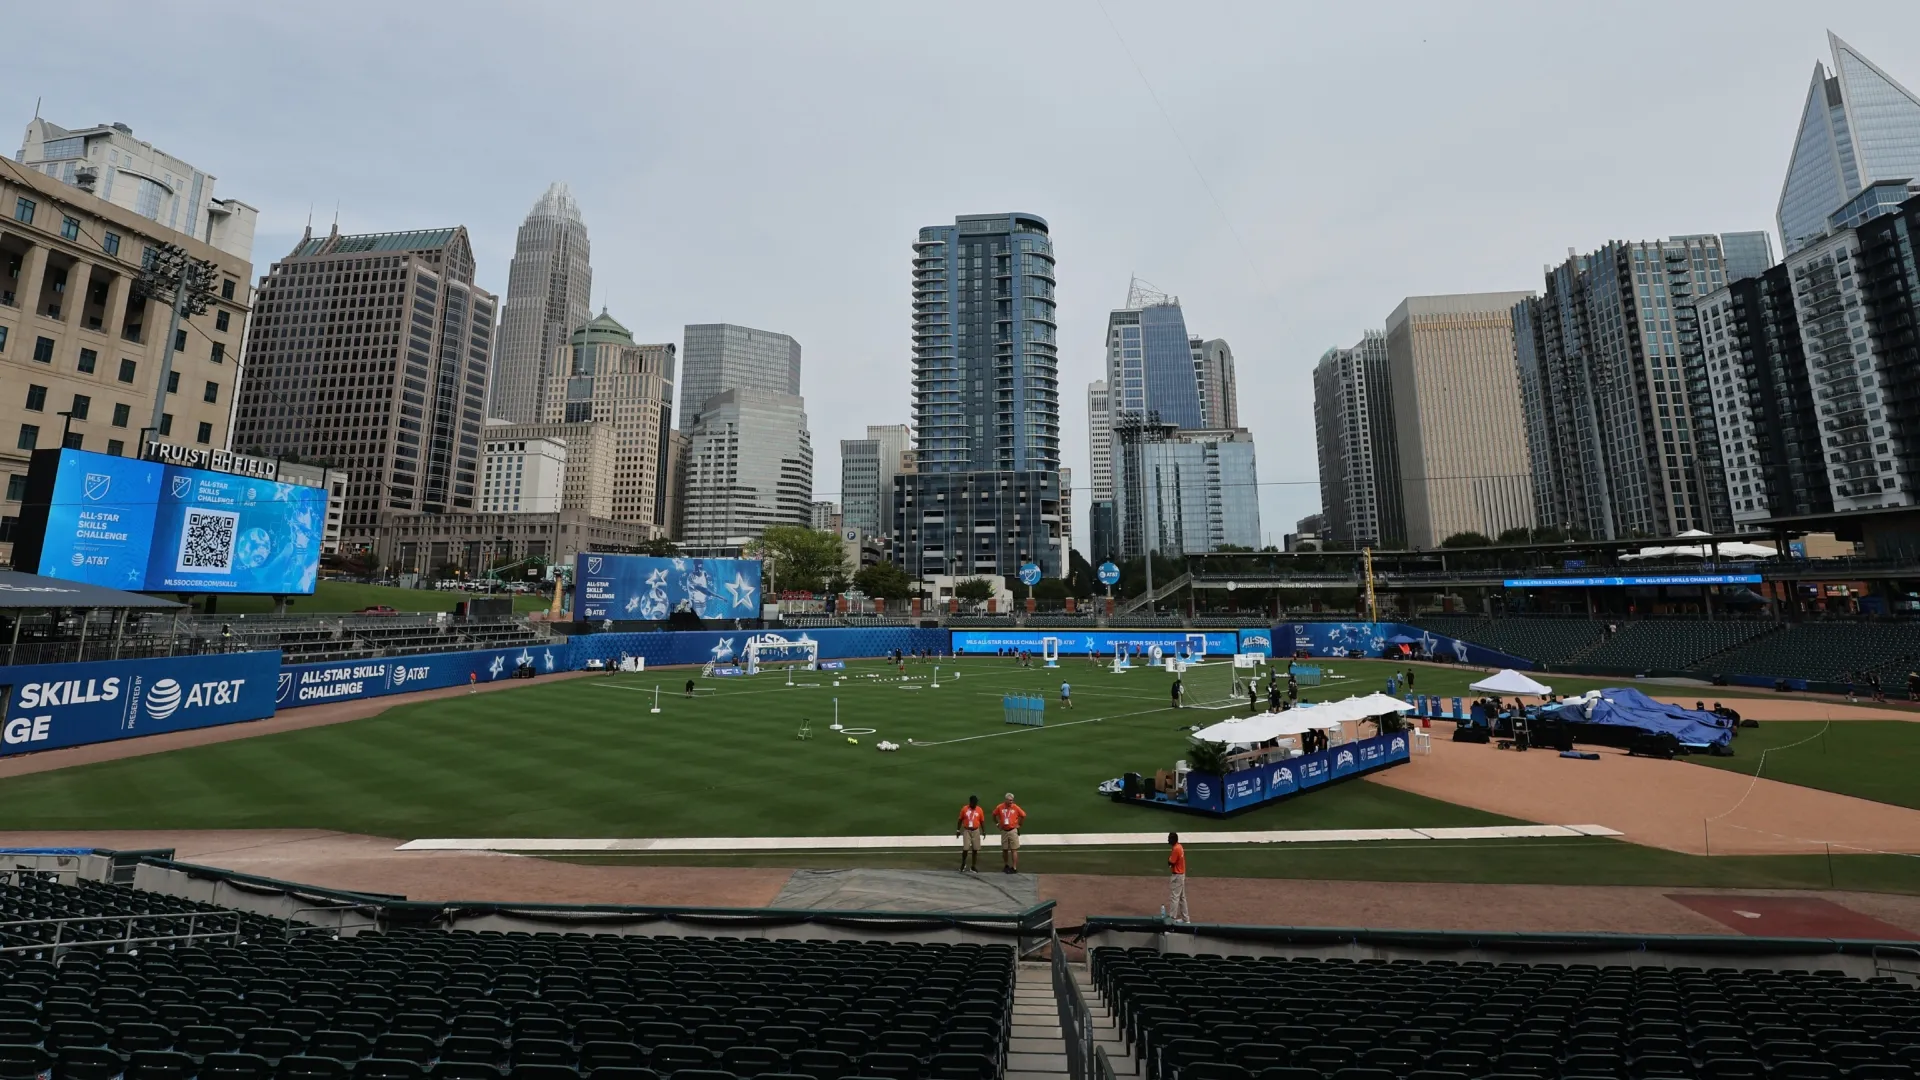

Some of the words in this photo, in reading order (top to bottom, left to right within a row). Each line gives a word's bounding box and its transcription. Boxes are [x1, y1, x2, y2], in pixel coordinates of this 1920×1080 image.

[149, 441, 209, 464] TRUIST
[234, 457, 275, 475] FIELD
[199, 480, 228, 490] ALL-STAR
[198, 487, 220, 496] SKILLS
[197, 495, 234, 505] CHALLENGE
[79, 511, 120, 522] ALL-STAR
[78, 520, 107, 530] SKILLS
[76, 530, 128, 541] CHALLENGE
[86, 555, 109, 565] AT&T
[301, 667, 351, 684] ALL-STAR
[353, 665, 385, 678] SKILLS
[406, 667, 430, 680] AT&T
[19, 677, 120, 709] SKILLS
[184, 679, 245, 709] AT&T
[299, 682, 363, 700] CHALLENGE
[128, 688, 141, 729] PRESENTED
[136, 675, 143, 686] BY
